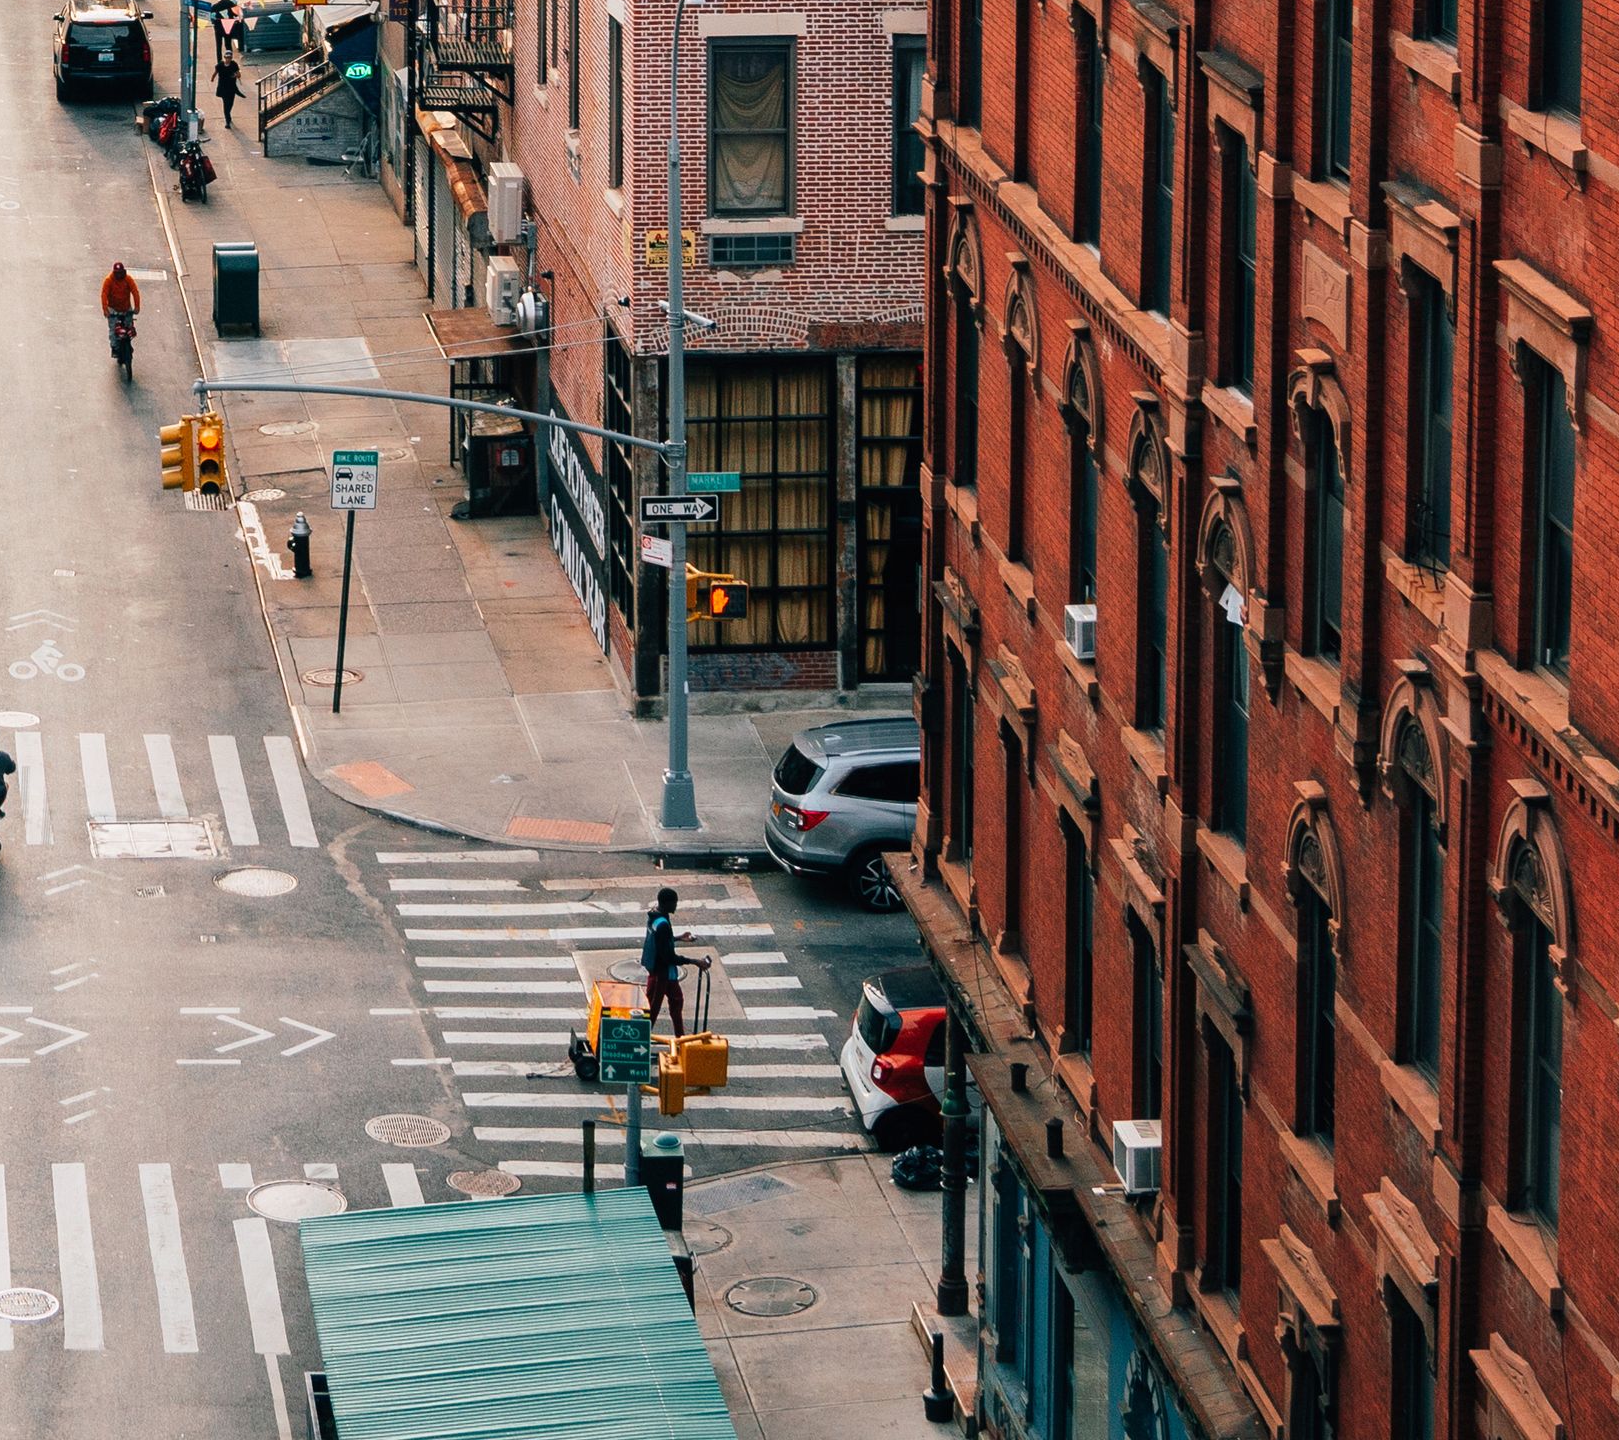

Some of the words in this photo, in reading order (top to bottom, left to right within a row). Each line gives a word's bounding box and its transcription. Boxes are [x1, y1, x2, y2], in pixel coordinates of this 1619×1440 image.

[345, 65, 372, 77] ATM
[353, 454, 376, 463] ROUTE
[335, 483, 374, 493] SHARED
[340, 495, 366, 505] LANE
[651, 504, 674, 514] ONE
[683, 503, 706, 514] WAY
[603, 1042, 617, 1050] East
[630, 1069, 647, 1077] West
